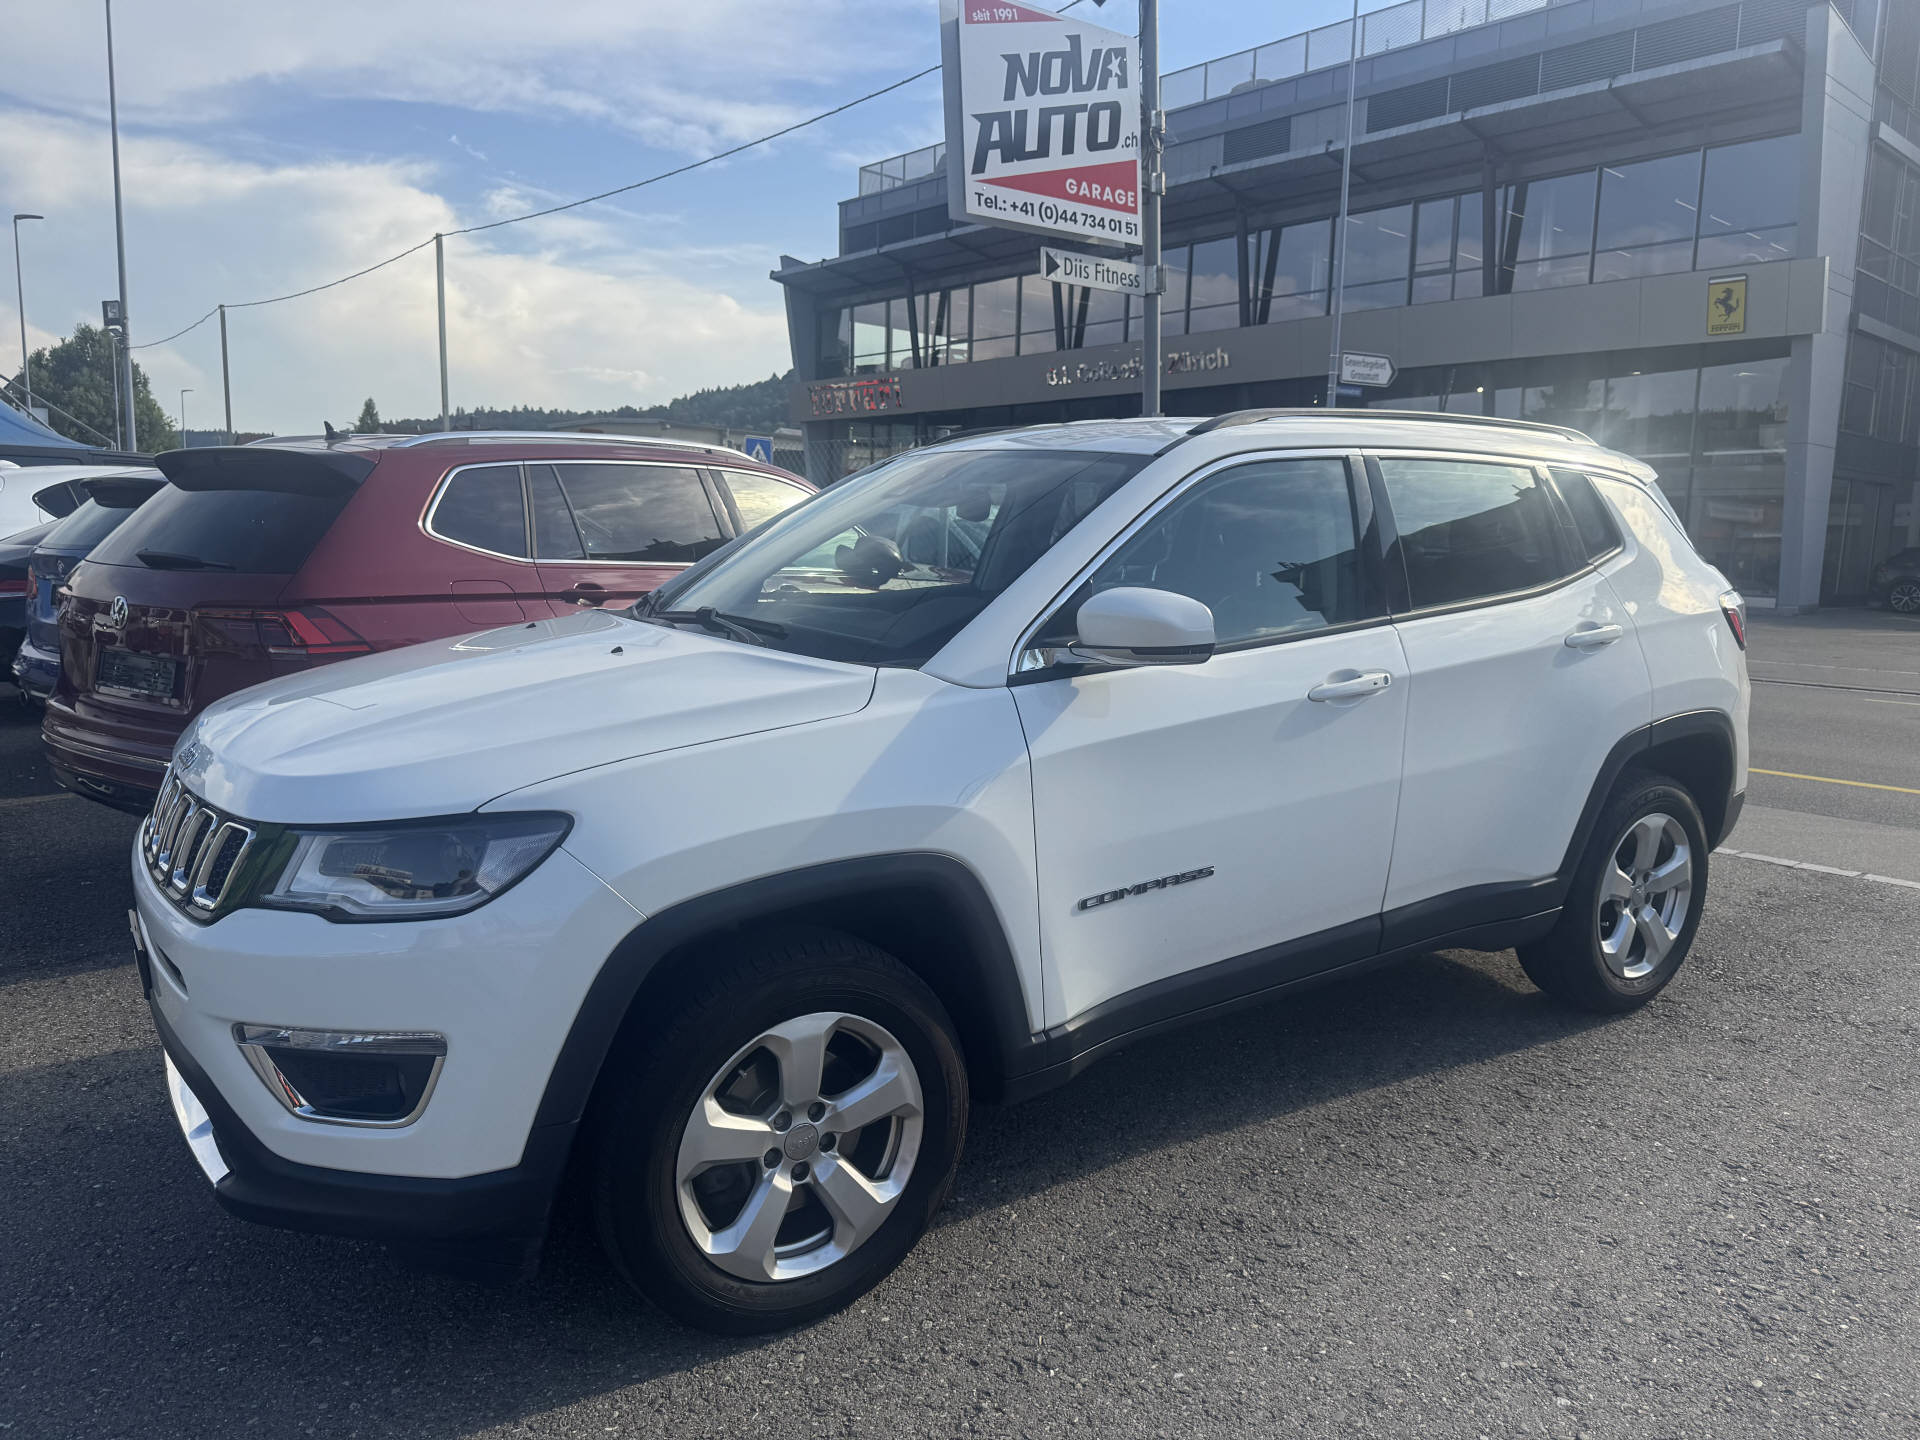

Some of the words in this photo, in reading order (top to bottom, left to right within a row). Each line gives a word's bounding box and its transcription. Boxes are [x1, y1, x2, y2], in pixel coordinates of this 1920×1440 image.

[972, 8, 990, 21] seit
[993, 8, 1018, 21] 1991
[1000, 34, 1129, 102] NOVA
[969, 100, 1122, 175] AUTO
[1065, 178, 1136, 207] GARAGE
[974, 192, 1007, 212] Tel.:
[1010, 201, 1035, 217] +41
[1081, 213, 1106, 230] 734
[1108, 219, 1122, 234] 01
[1125, 223, 1138, 236] 51
[1063, 257, 1090, 280] Diis
[1095, 263, 1141, 289] Fitness
[1167, 347, 1230, 374] Zürich
[1078, 865, 1215, 911] COMPASS
